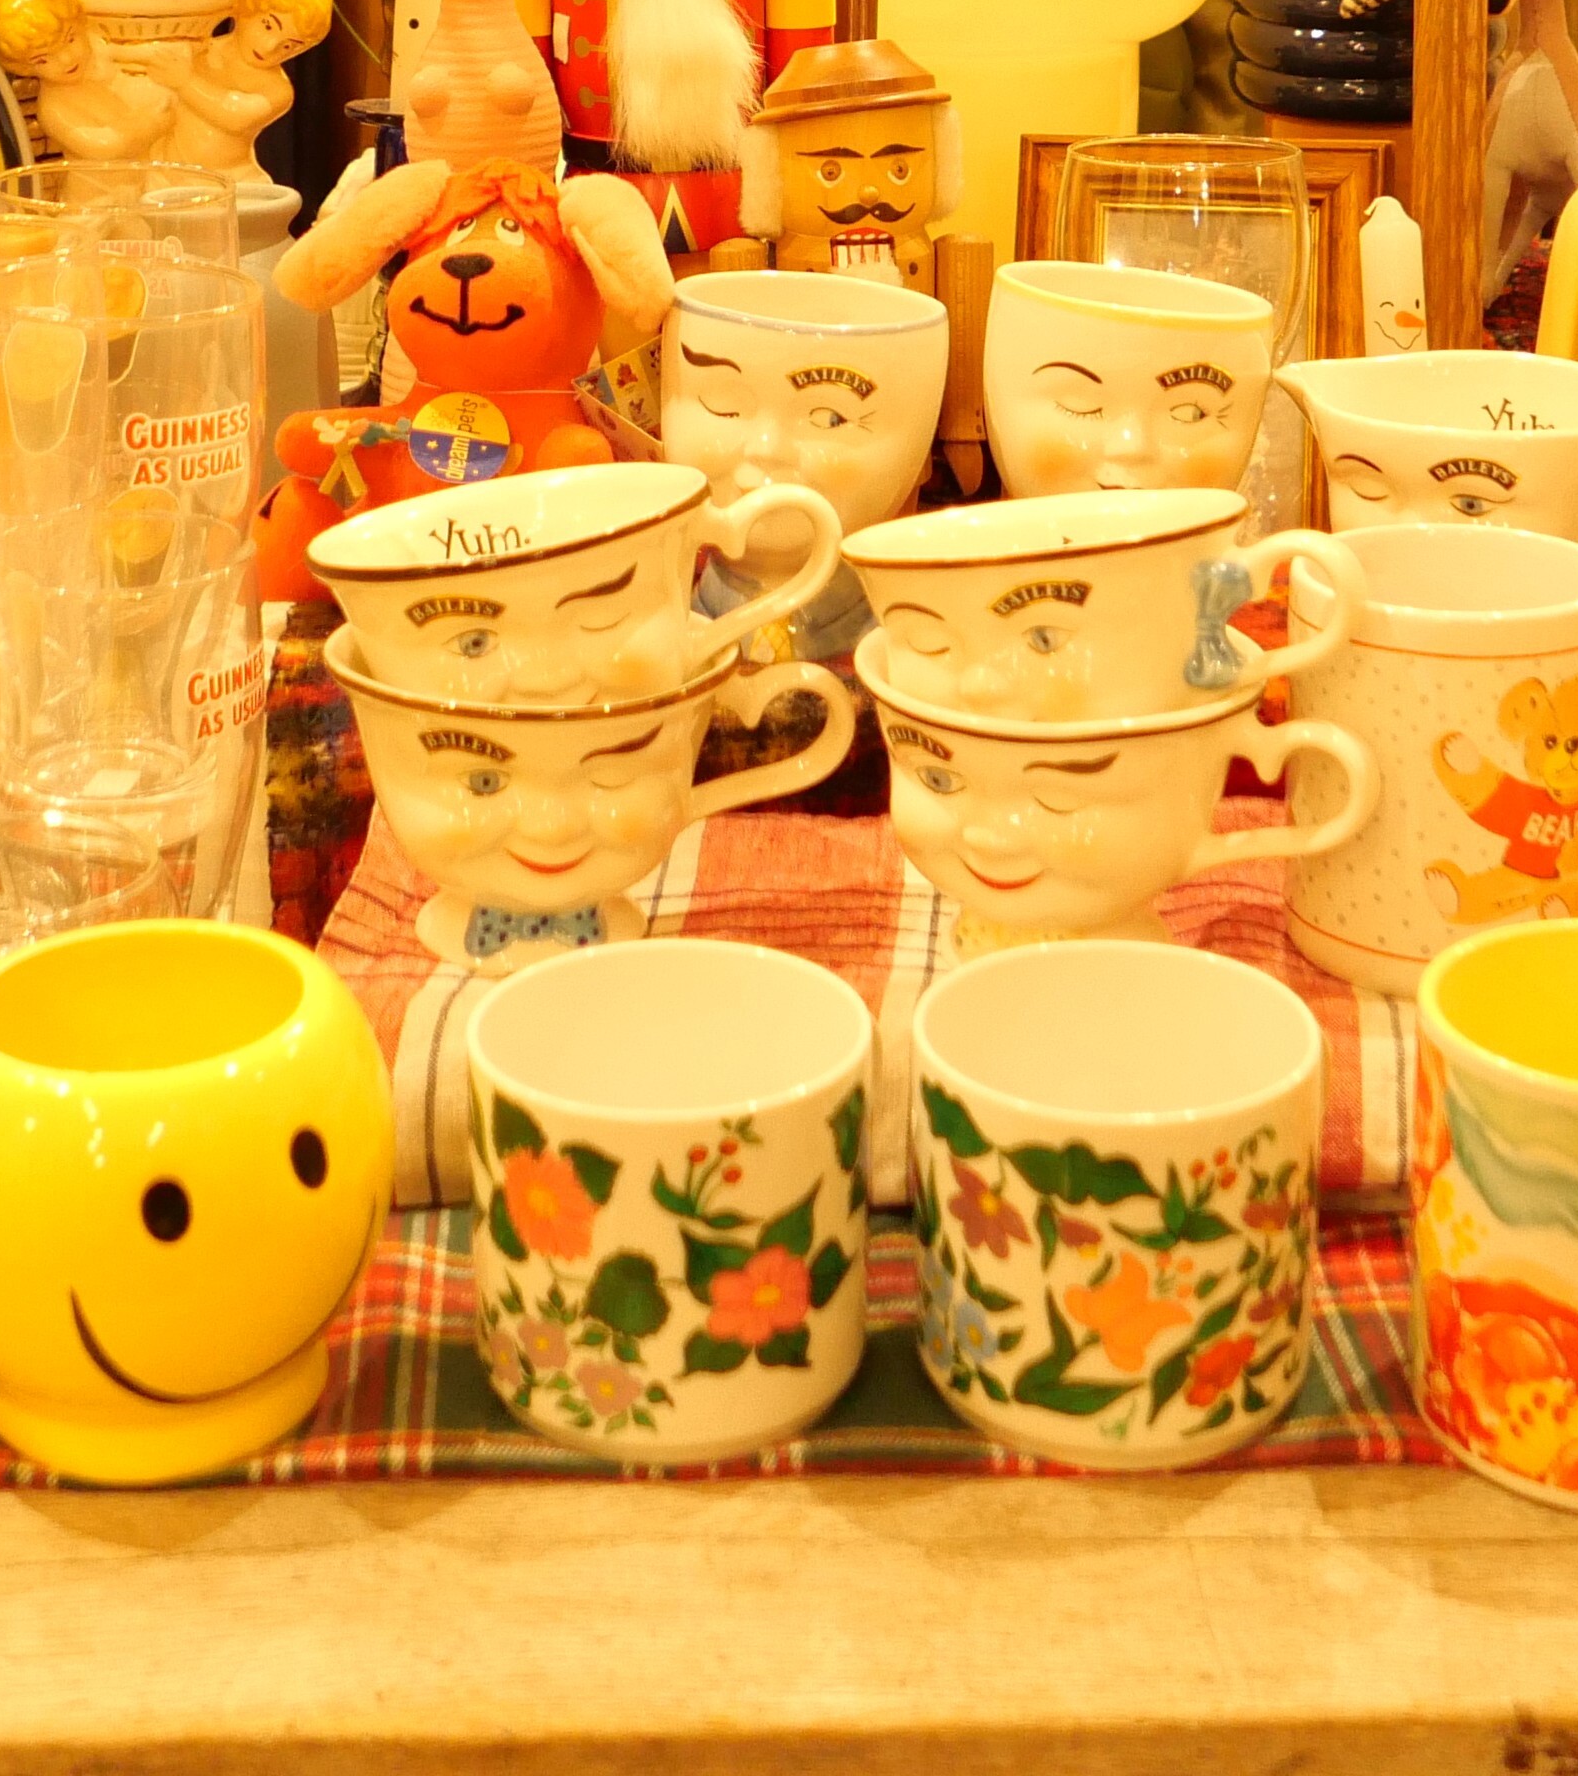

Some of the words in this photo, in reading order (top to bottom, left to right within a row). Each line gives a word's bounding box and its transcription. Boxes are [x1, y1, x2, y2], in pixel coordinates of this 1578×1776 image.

[794, 367, 873, 395] BAILEYS
[1163, 366, 1231, 391] BAILEYS
[124, 405, 249, 450] GUINNESS
[437, 437, 470, 481] dream
[456, 398, 481, 435] pets
[132, 459, 168, 485] AS
[181, 443, 243, 481] USUAL
[1432, 459, 1517, 485] BAILEYS
[429, 517, 531, 559] Yum.
[410, 597, 499, 624] BAILEYS
[995, 582, 1086, 615] BAILEYS
[187, 648, 264, 706] GUINNES
[197, 710, 224, 740] AS
[423, 731, 507, 761] BAILEYS
